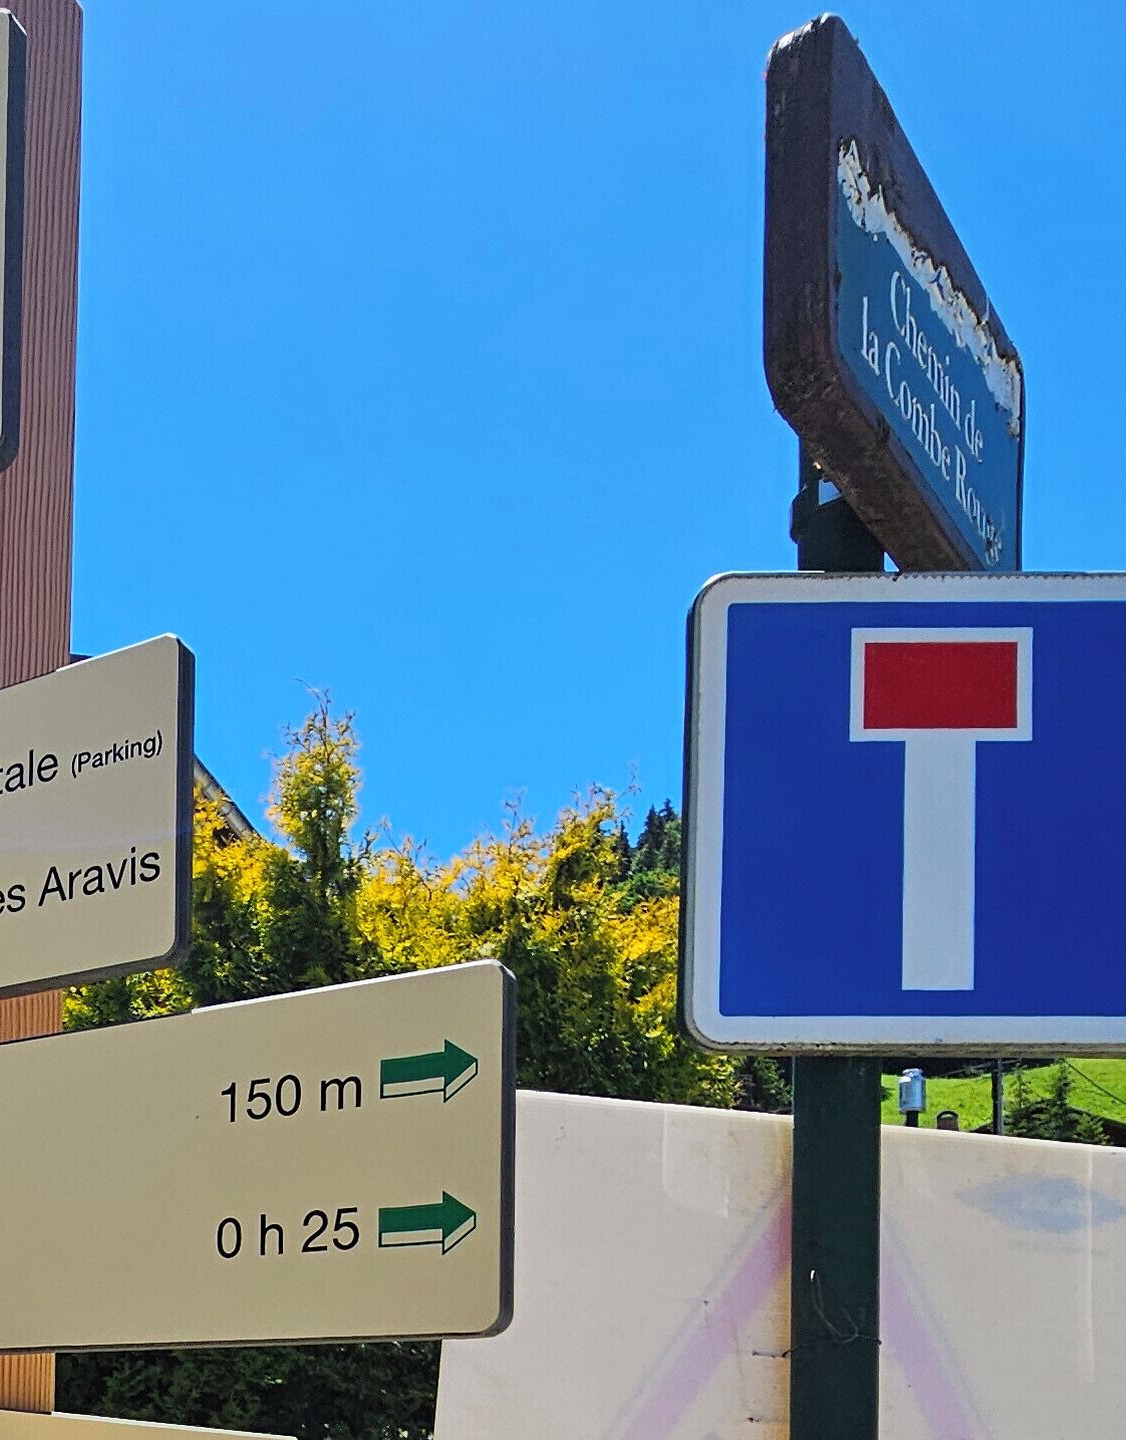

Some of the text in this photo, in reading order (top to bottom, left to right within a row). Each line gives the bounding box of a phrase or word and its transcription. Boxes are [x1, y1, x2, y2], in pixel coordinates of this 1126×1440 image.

[861, 295, 881, 377] la
[885, 340, 952, 482] Combe
[889, 270, 984, 464] Chemin de
[71, 730, 163, 779] (Parking)
[37, 847, 161, 907] Aravis
[220, 1074, 362, 1123] 150 m
[301, 1206, 360, 1253] 25
